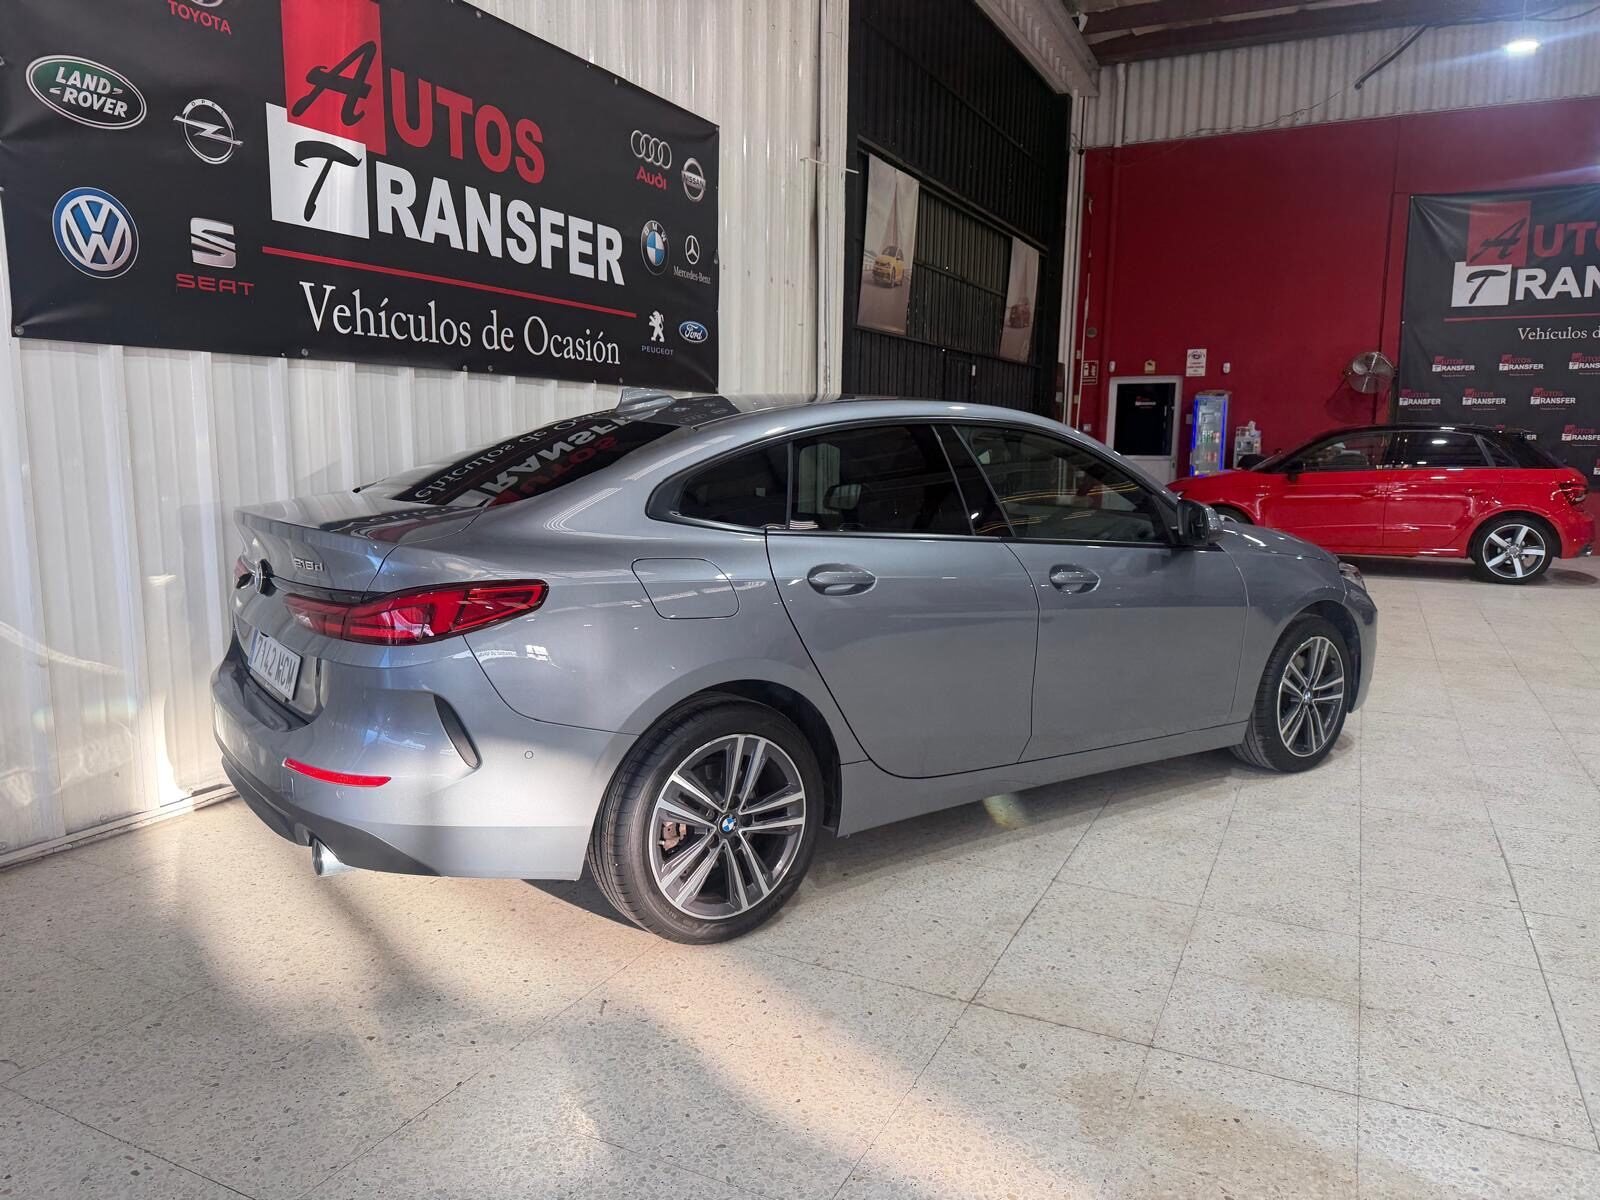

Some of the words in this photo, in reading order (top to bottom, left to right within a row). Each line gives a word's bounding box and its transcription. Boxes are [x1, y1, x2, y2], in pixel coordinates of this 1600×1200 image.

[167, 0, 232, 35] TOYOTA
[55, 66, 112, 96] LAND
[62, 87, 128, 118] ROVER
[291, 40, 545, 184] AUTOS
[636, 166, 667, 190] Audi
[294, 140, 625, 286] TRANSFER
[644, 222, 667, 242] BMW
[1469, 216, 1600, 263] AUT
[176, 273, 254, 296] SEAT
[673, 265, 711, 284] Mercedes-Benz
[299, 281, 472, 347] Vehículos
[482, 310, 514, 352] de
[523, 315, 621, 365] Ocasión
[684, 323, 703, 340] Ford
[1518, 326, 1588, 340] Vehículos
[641, 345, 674, 355] PEUGEOT
